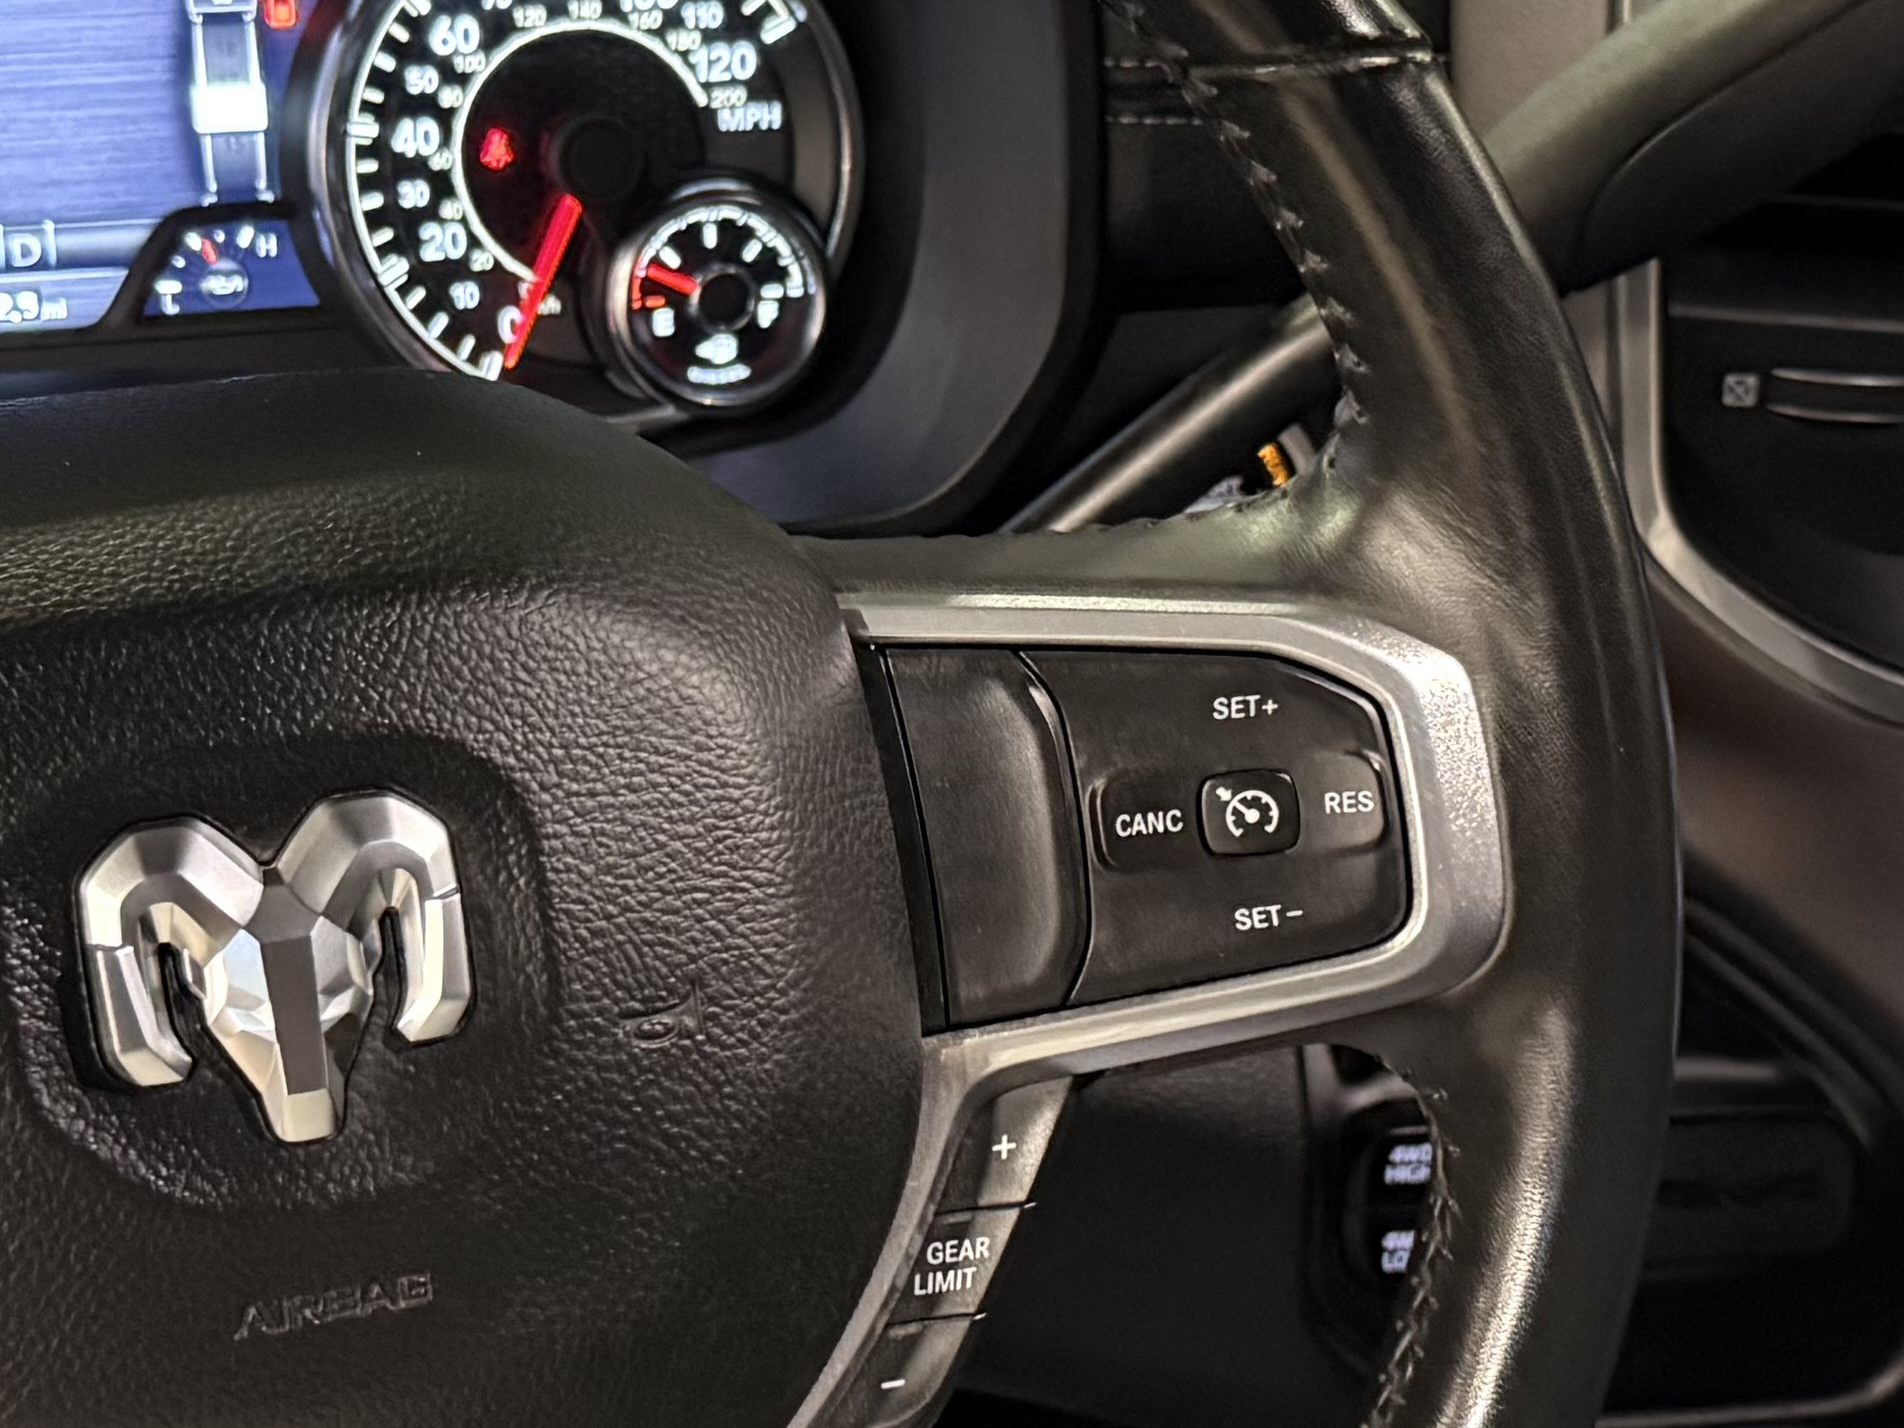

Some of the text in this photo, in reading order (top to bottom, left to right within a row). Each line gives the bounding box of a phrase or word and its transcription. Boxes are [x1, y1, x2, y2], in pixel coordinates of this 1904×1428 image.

[512, 4, 547, 28] 120
[680, 0, 724, 29] 110
[429, 13, 480, 56] 60
[453, 50, 486, 74] 100
[688, 40, 757, 83] 120
[404, 65, 439, 95] 50
[709, 84, 747, 109] 200
[717, 100, 782, 132] MPH
[391, 116, 440, 158] 40
[397, 179, 430, 209] 30
[11, 233, 42, 268] D
[255, 233, 278, 258] H
[418, 221, 467, 262] 20
[469, 249, 494, 272] 20
[449, 281, 480, 310] 10
[652, 307, 675, 337] E
[1212, 695, 1279, 720] SET+
[1324, 790, 1374, 815] RES
[1115, 809, 1184, 837] CANC
[926, 1236, 990, 1266] GEAR
[1381, 1231, 1415, 1252] 4W
[1381, 1251, 1411, 1274] LO
[913, 1267, 977, 1296] LIMIT
